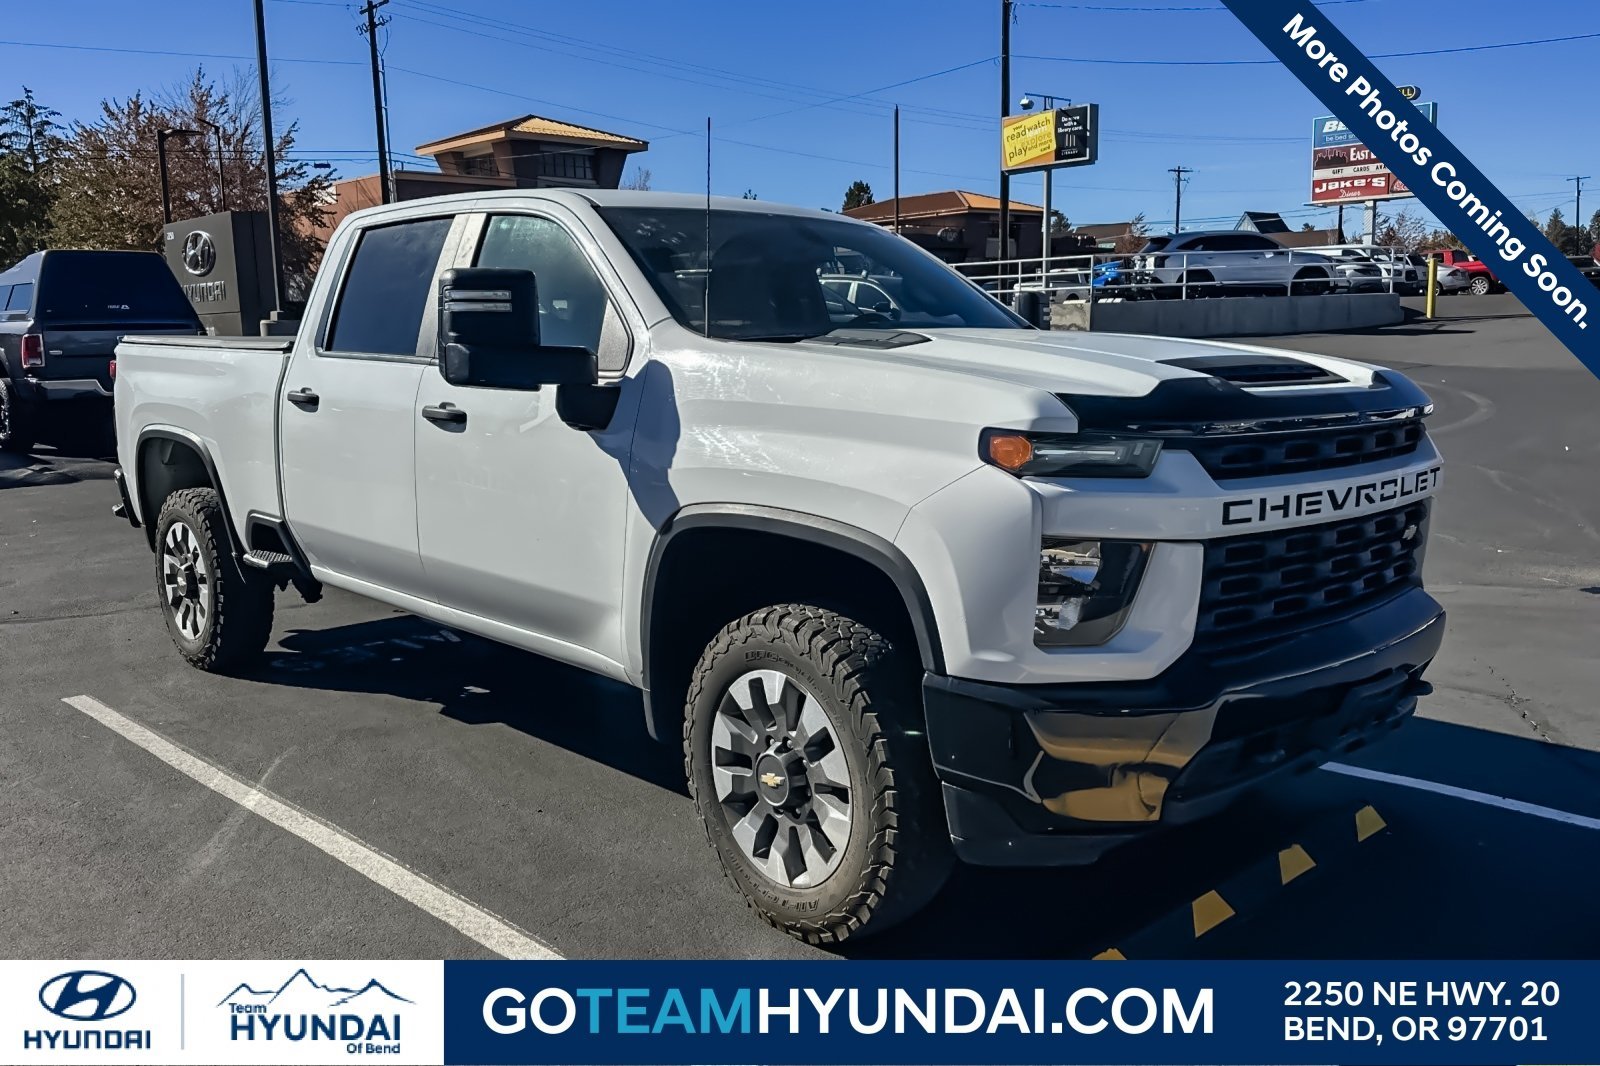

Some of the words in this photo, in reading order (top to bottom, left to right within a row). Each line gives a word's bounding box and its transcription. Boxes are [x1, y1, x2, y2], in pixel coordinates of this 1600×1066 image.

[1006, 125, 1026, 142] read
[1027, 117, 1051, 131] watch
[1009, 145, 1027, 162] play
[1221, 466, 1441, 525] CHEVROLET
